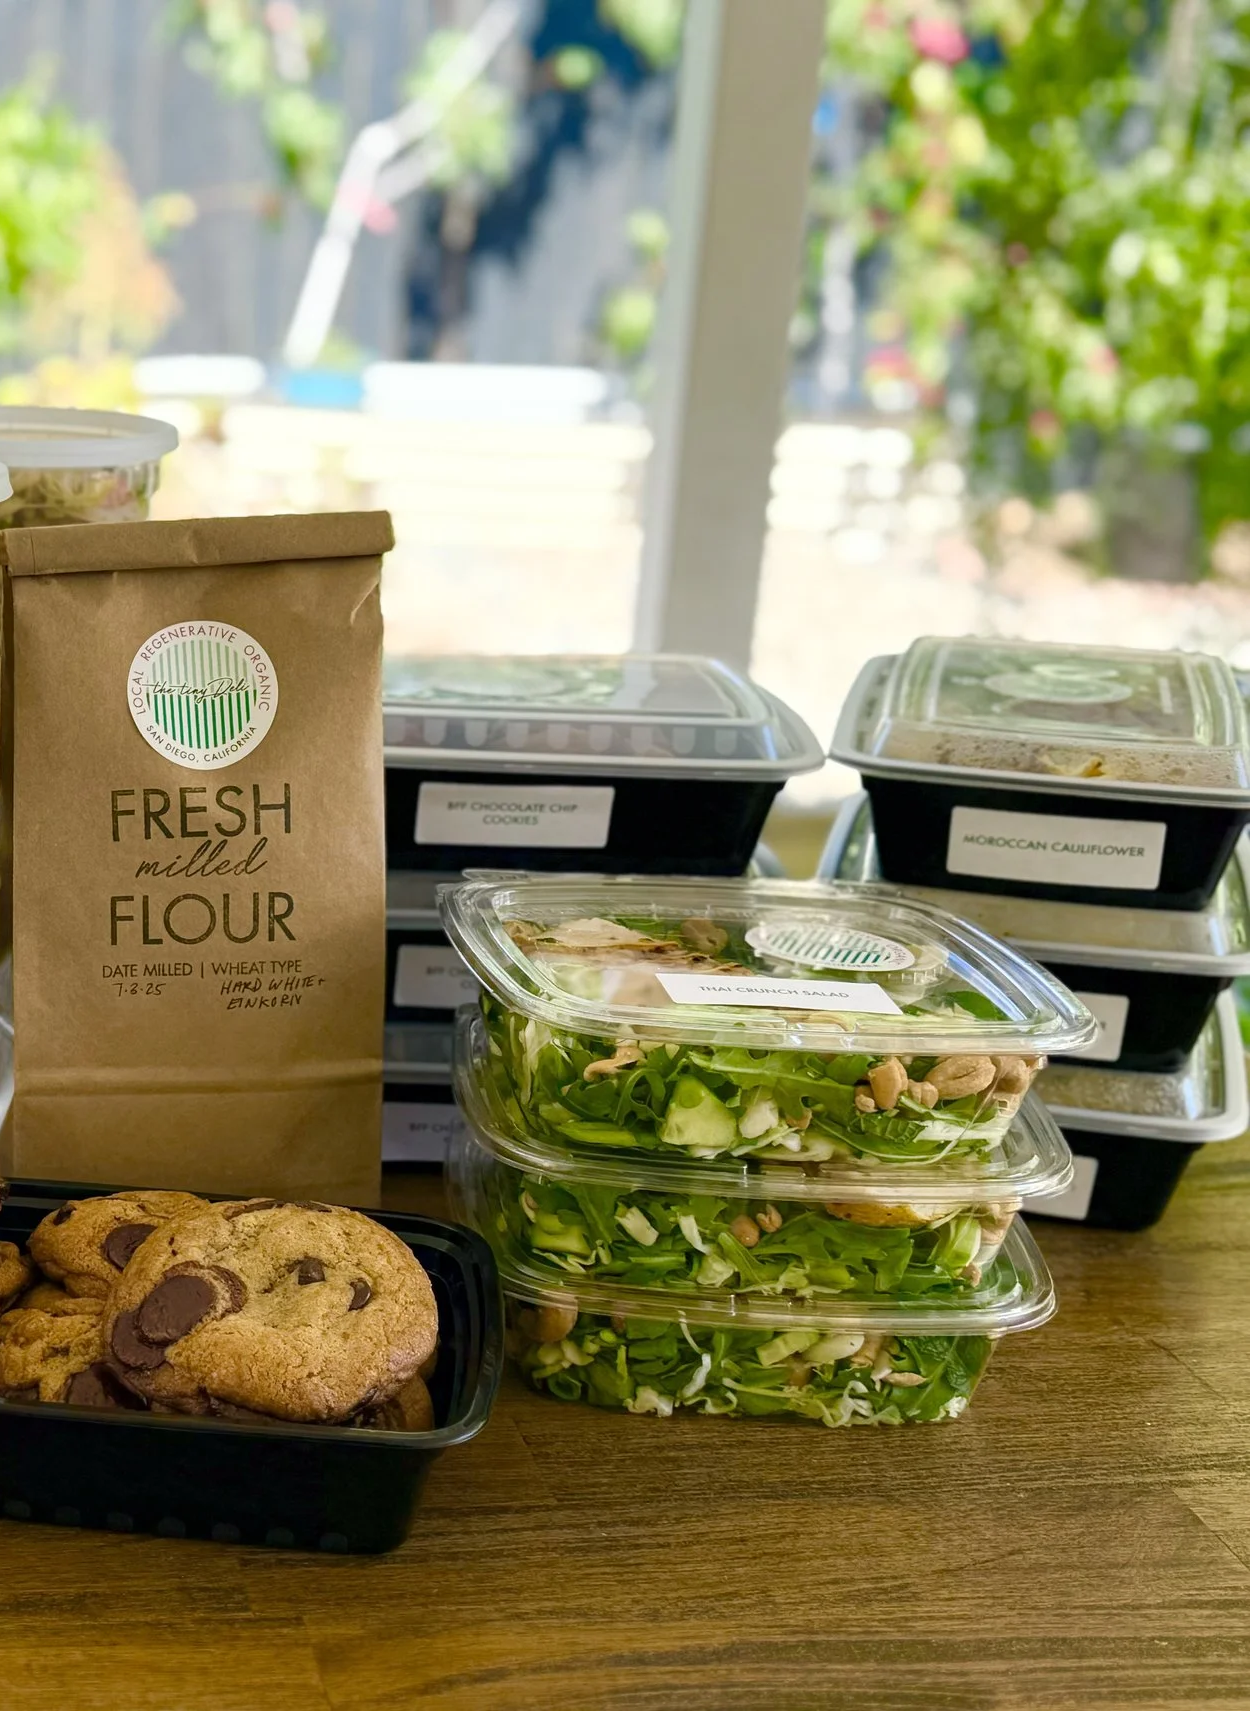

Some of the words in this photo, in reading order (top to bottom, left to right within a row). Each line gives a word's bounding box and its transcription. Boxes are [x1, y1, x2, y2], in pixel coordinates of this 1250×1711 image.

[131, 670, 146, 715] LOCAL
[141, 625, 237, 661] REGENERATIVE
[244, 645, 270, 711] ORGANIC
[146, 725, 163, 745] SAN
[204, 726, 257, 762] CALIFORNIA
[111, 783, 291, 842] FRESH
[470, 801, 546, 813] CHOCOLATE
[549, 803, 578, 813] CHIP
[482, 815, 539, 826] COOKIES
[963, 834, 1047, 851] MOROCCAN
[1051, 842, 1146, 857] CAULIFLOWER
[135, 837, 268, 878] milled
[110, 892, 296, 946] FLOUR
[102, 964, 138, 978] DATE
[143, 963, 193, 977] MILLED
[211, 961, 266, 976] WHEAT
[270, 960, 302, 975] TYPE
[220, 977, 262, 996] HARD
[699, 985, 732, 993] THAI
[737, 986, 798, 996] CRUNCH
[803, 990, 850, 998] SALAD
